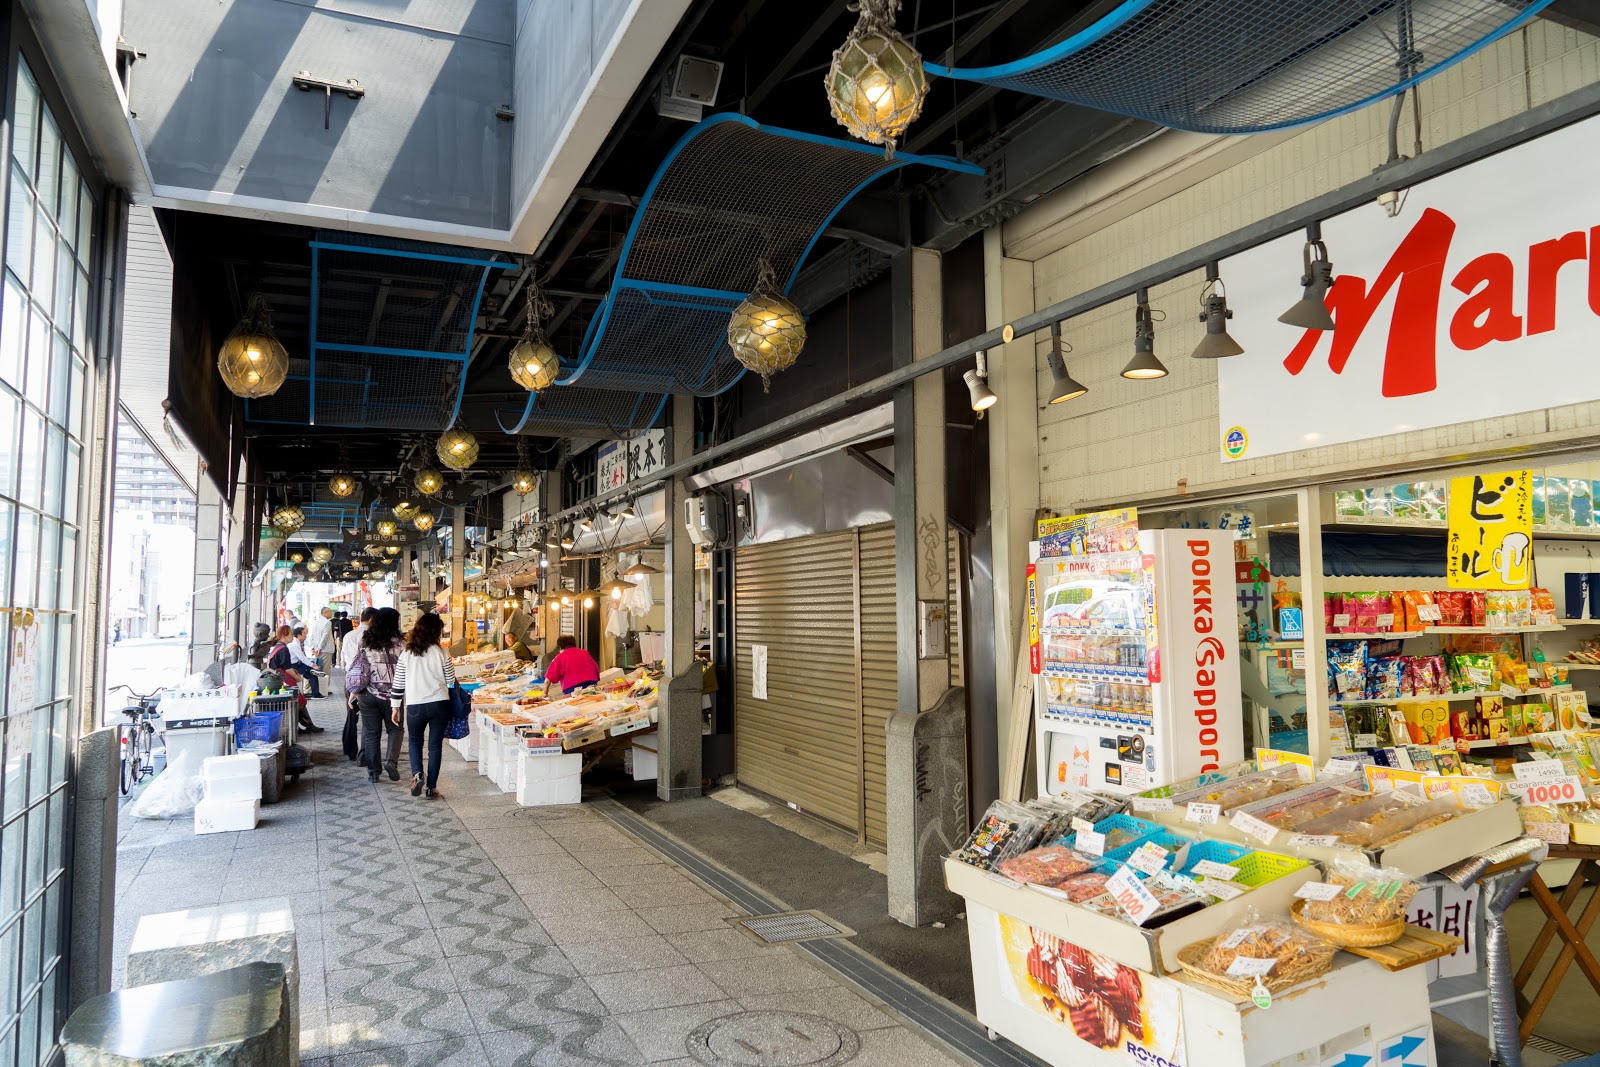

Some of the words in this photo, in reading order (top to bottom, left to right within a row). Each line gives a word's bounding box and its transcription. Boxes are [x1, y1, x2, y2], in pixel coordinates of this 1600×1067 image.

[1517, 471, 1528, 525] よく冷えた
[1462, 476, 1515, 578] ビール
[1187, 540, 1213, 634] pokka
[1509, 780, 1553, 790] Clearance
[1555, 777, 1575, 785] Sale
[1526, 783, 1575, 803] 1000
[1117, 888, 1144, 916] 1000
